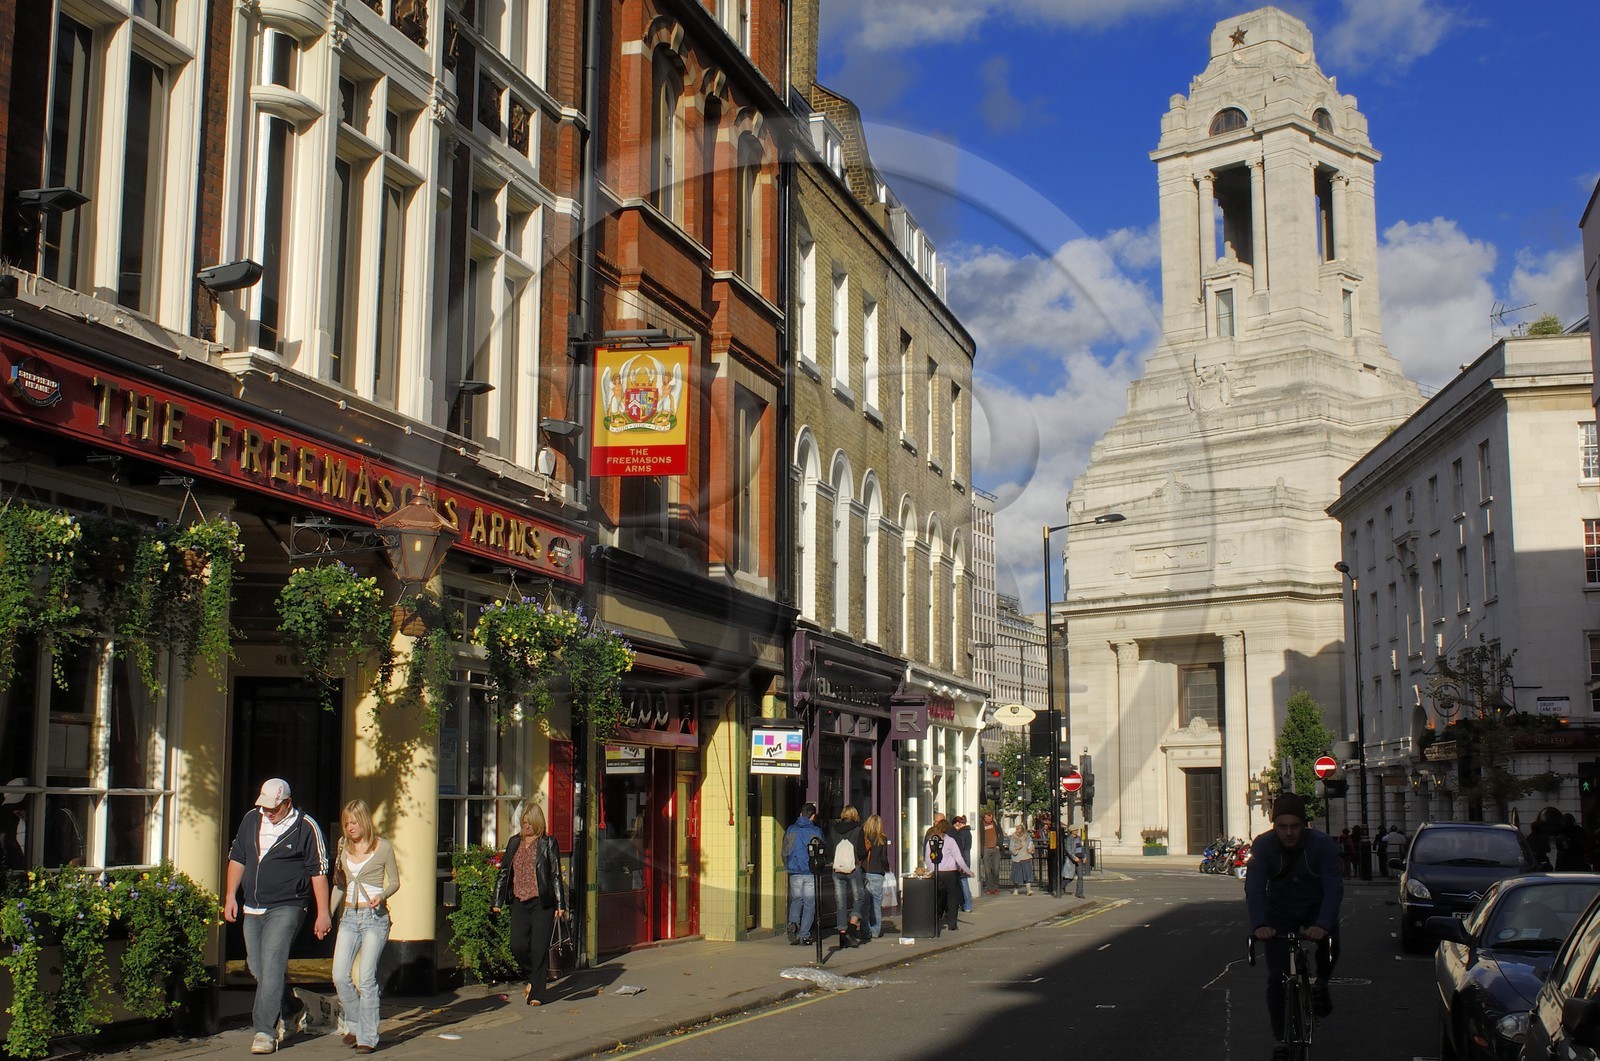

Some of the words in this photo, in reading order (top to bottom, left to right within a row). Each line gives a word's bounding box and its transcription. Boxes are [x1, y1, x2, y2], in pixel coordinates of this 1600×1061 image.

[630, 448, 649, 456] THE
[606, 456, 672, 464] FREEMASONS
[93, 374, 188, 453] THE
[210, 416, 459, 532] FREEMASOS
[470, 506, 542, 560] ARMS
[625, 465, 652, 473] ARMS
